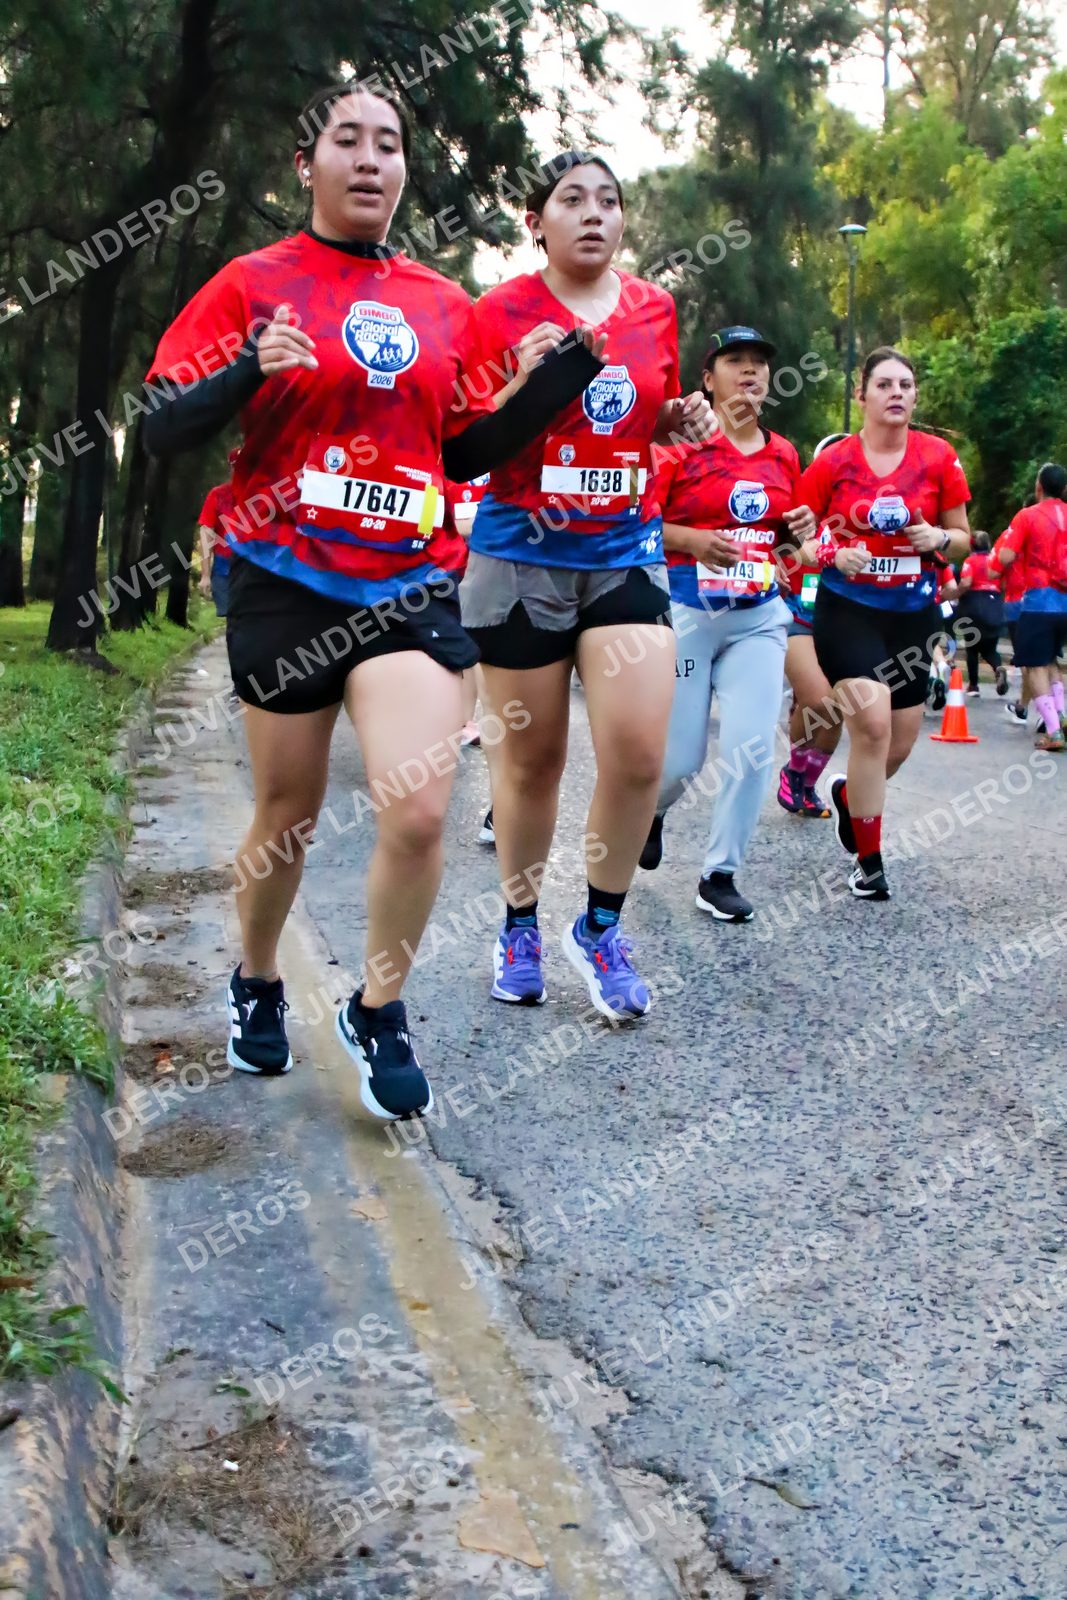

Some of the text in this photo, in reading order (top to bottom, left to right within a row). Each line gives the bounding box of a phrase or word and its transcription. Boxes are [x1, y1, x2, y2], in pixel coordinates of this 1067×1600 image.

[360, 308, 397, 321] BIMBO
[361, 320, 400, 336] Global
[355, 330, 386, 343] Race
[370, 374, 393, 386] 2026
[596, 382, 624, 393] Global
[590, 392, 613, 402] Race
[580, 470, 622, 492] 1638
[343, 480, 411, 517] 17647
